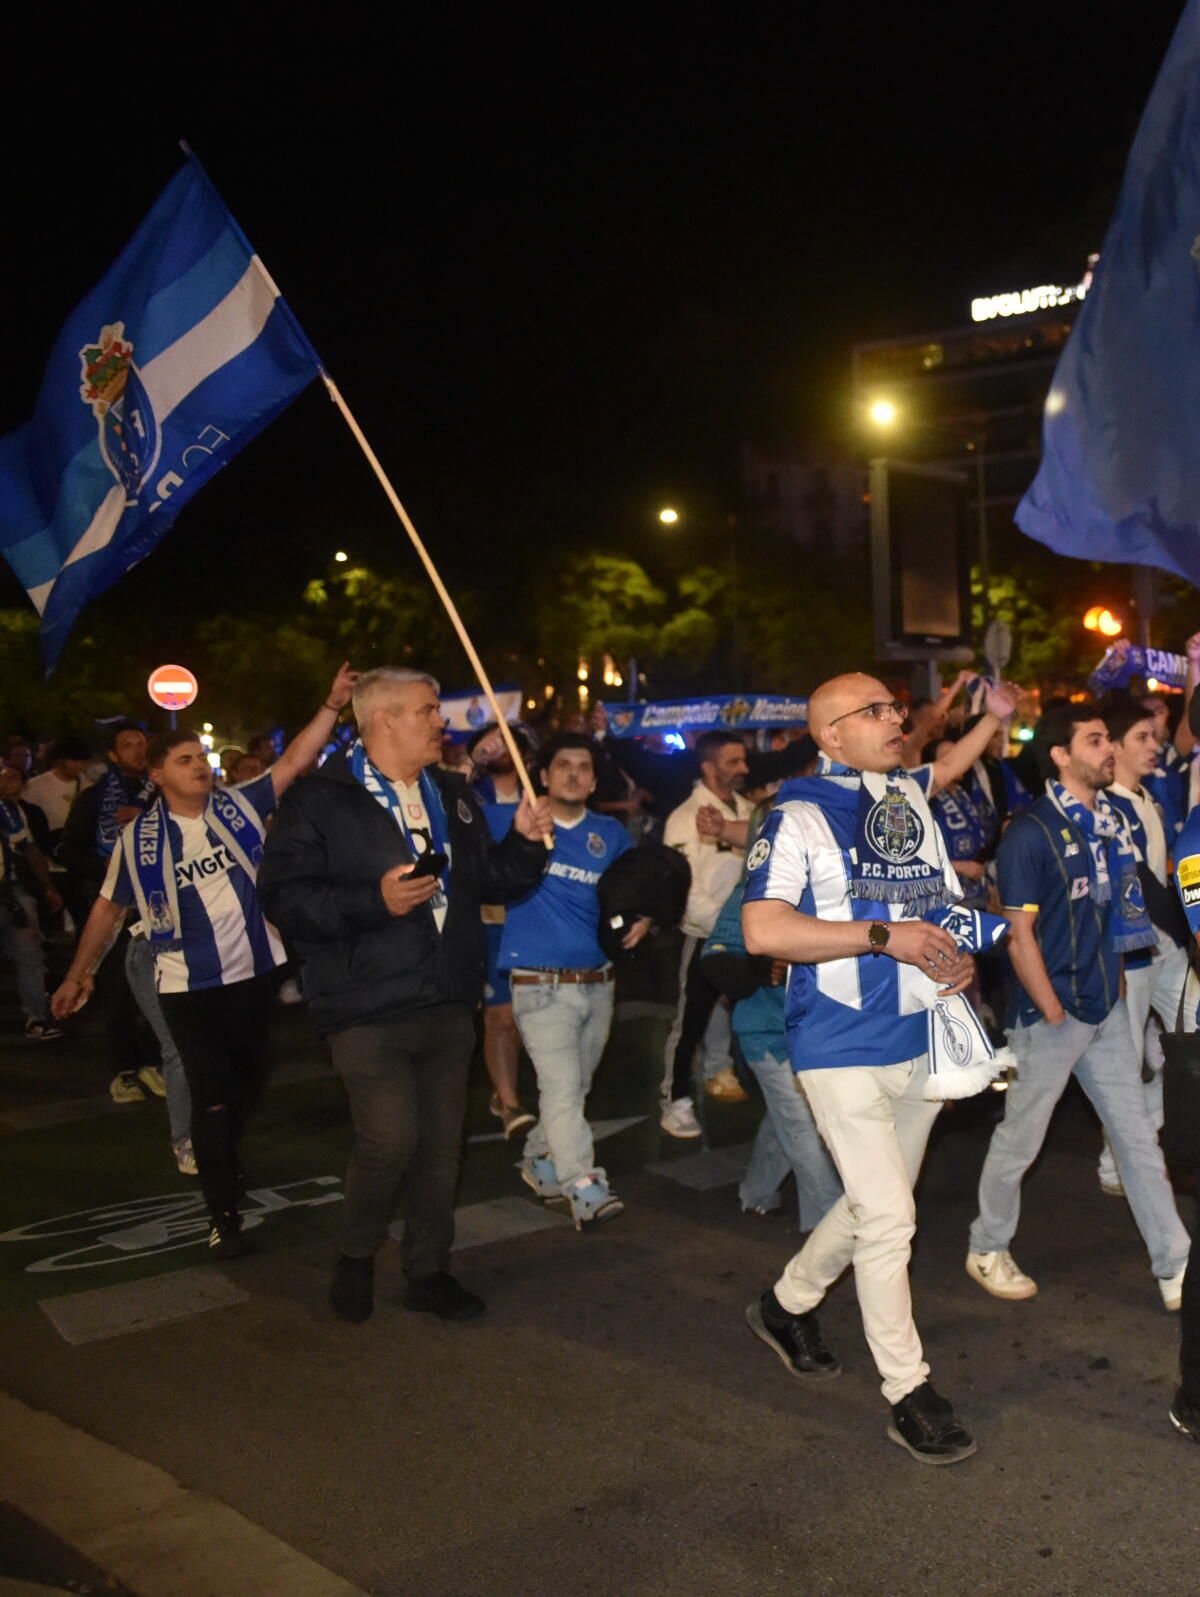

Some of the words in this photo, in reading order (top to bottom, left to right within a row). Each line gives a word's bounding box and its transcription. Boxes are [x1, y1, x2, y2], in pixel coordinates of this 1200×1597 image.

[548, 862, 601, 885] BETAN
[861, 862, 886, 878] F.C.
[887, 863, 931, 879] PORTO
